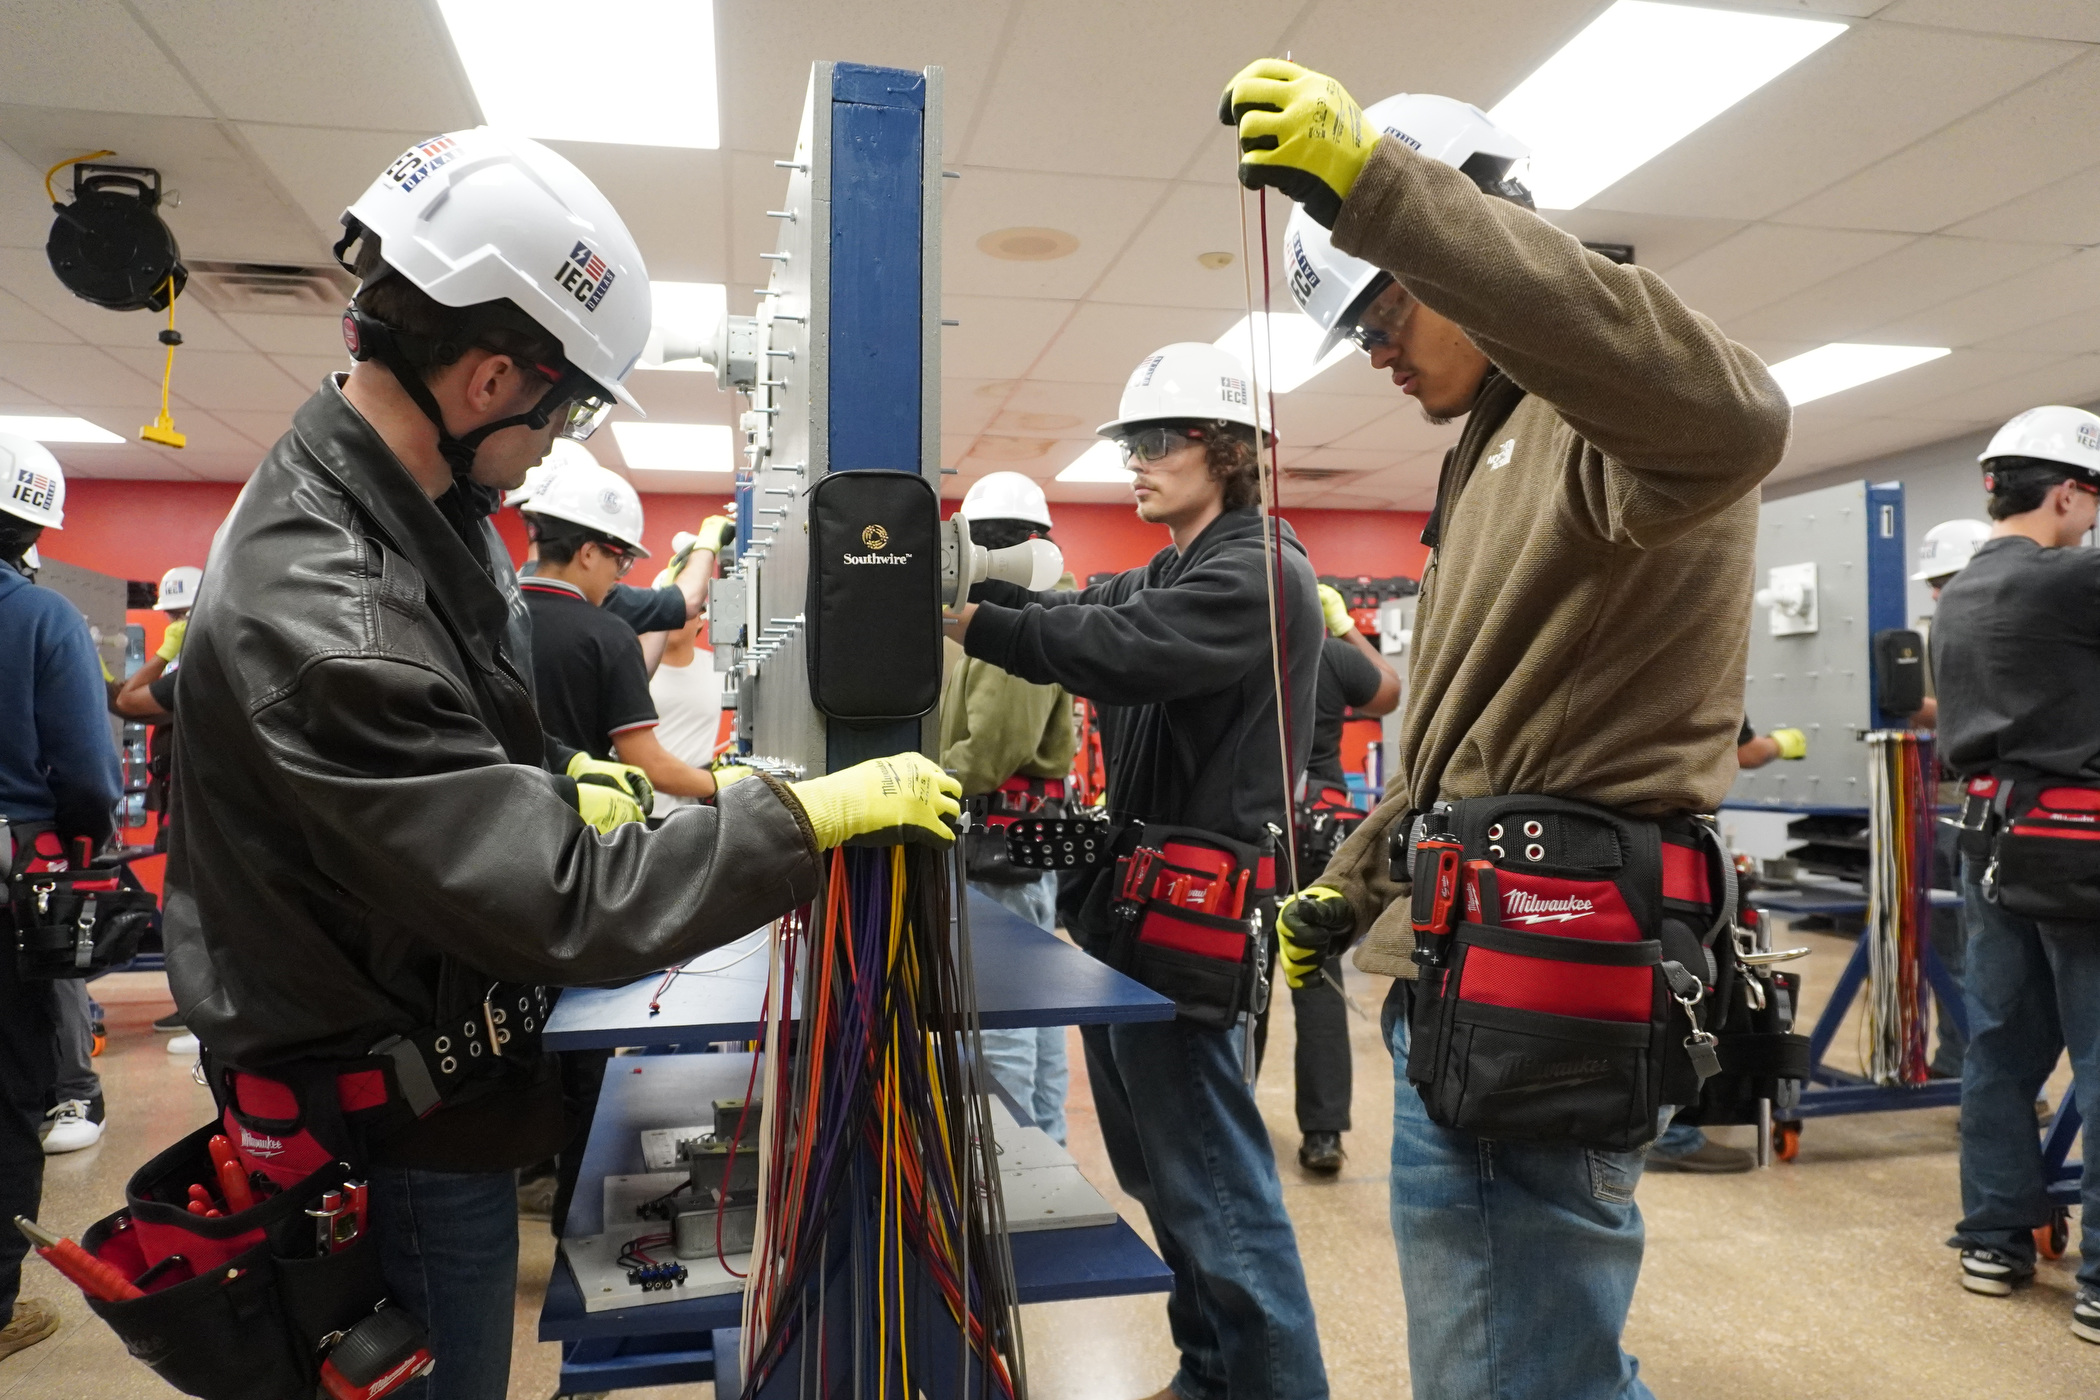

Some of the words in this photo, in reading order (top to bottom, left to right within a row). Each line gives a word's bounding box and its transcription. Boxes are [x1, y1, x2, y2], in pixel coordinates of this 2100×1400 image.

[554, 260, 595, 303] IEC
[586, 270, 615, 311] DALLAS
[1221, 389, 1241, 404] IEC
[12, 484, 44, 507] IEC
[1503, 889, 1594, 915] Milwaukee
